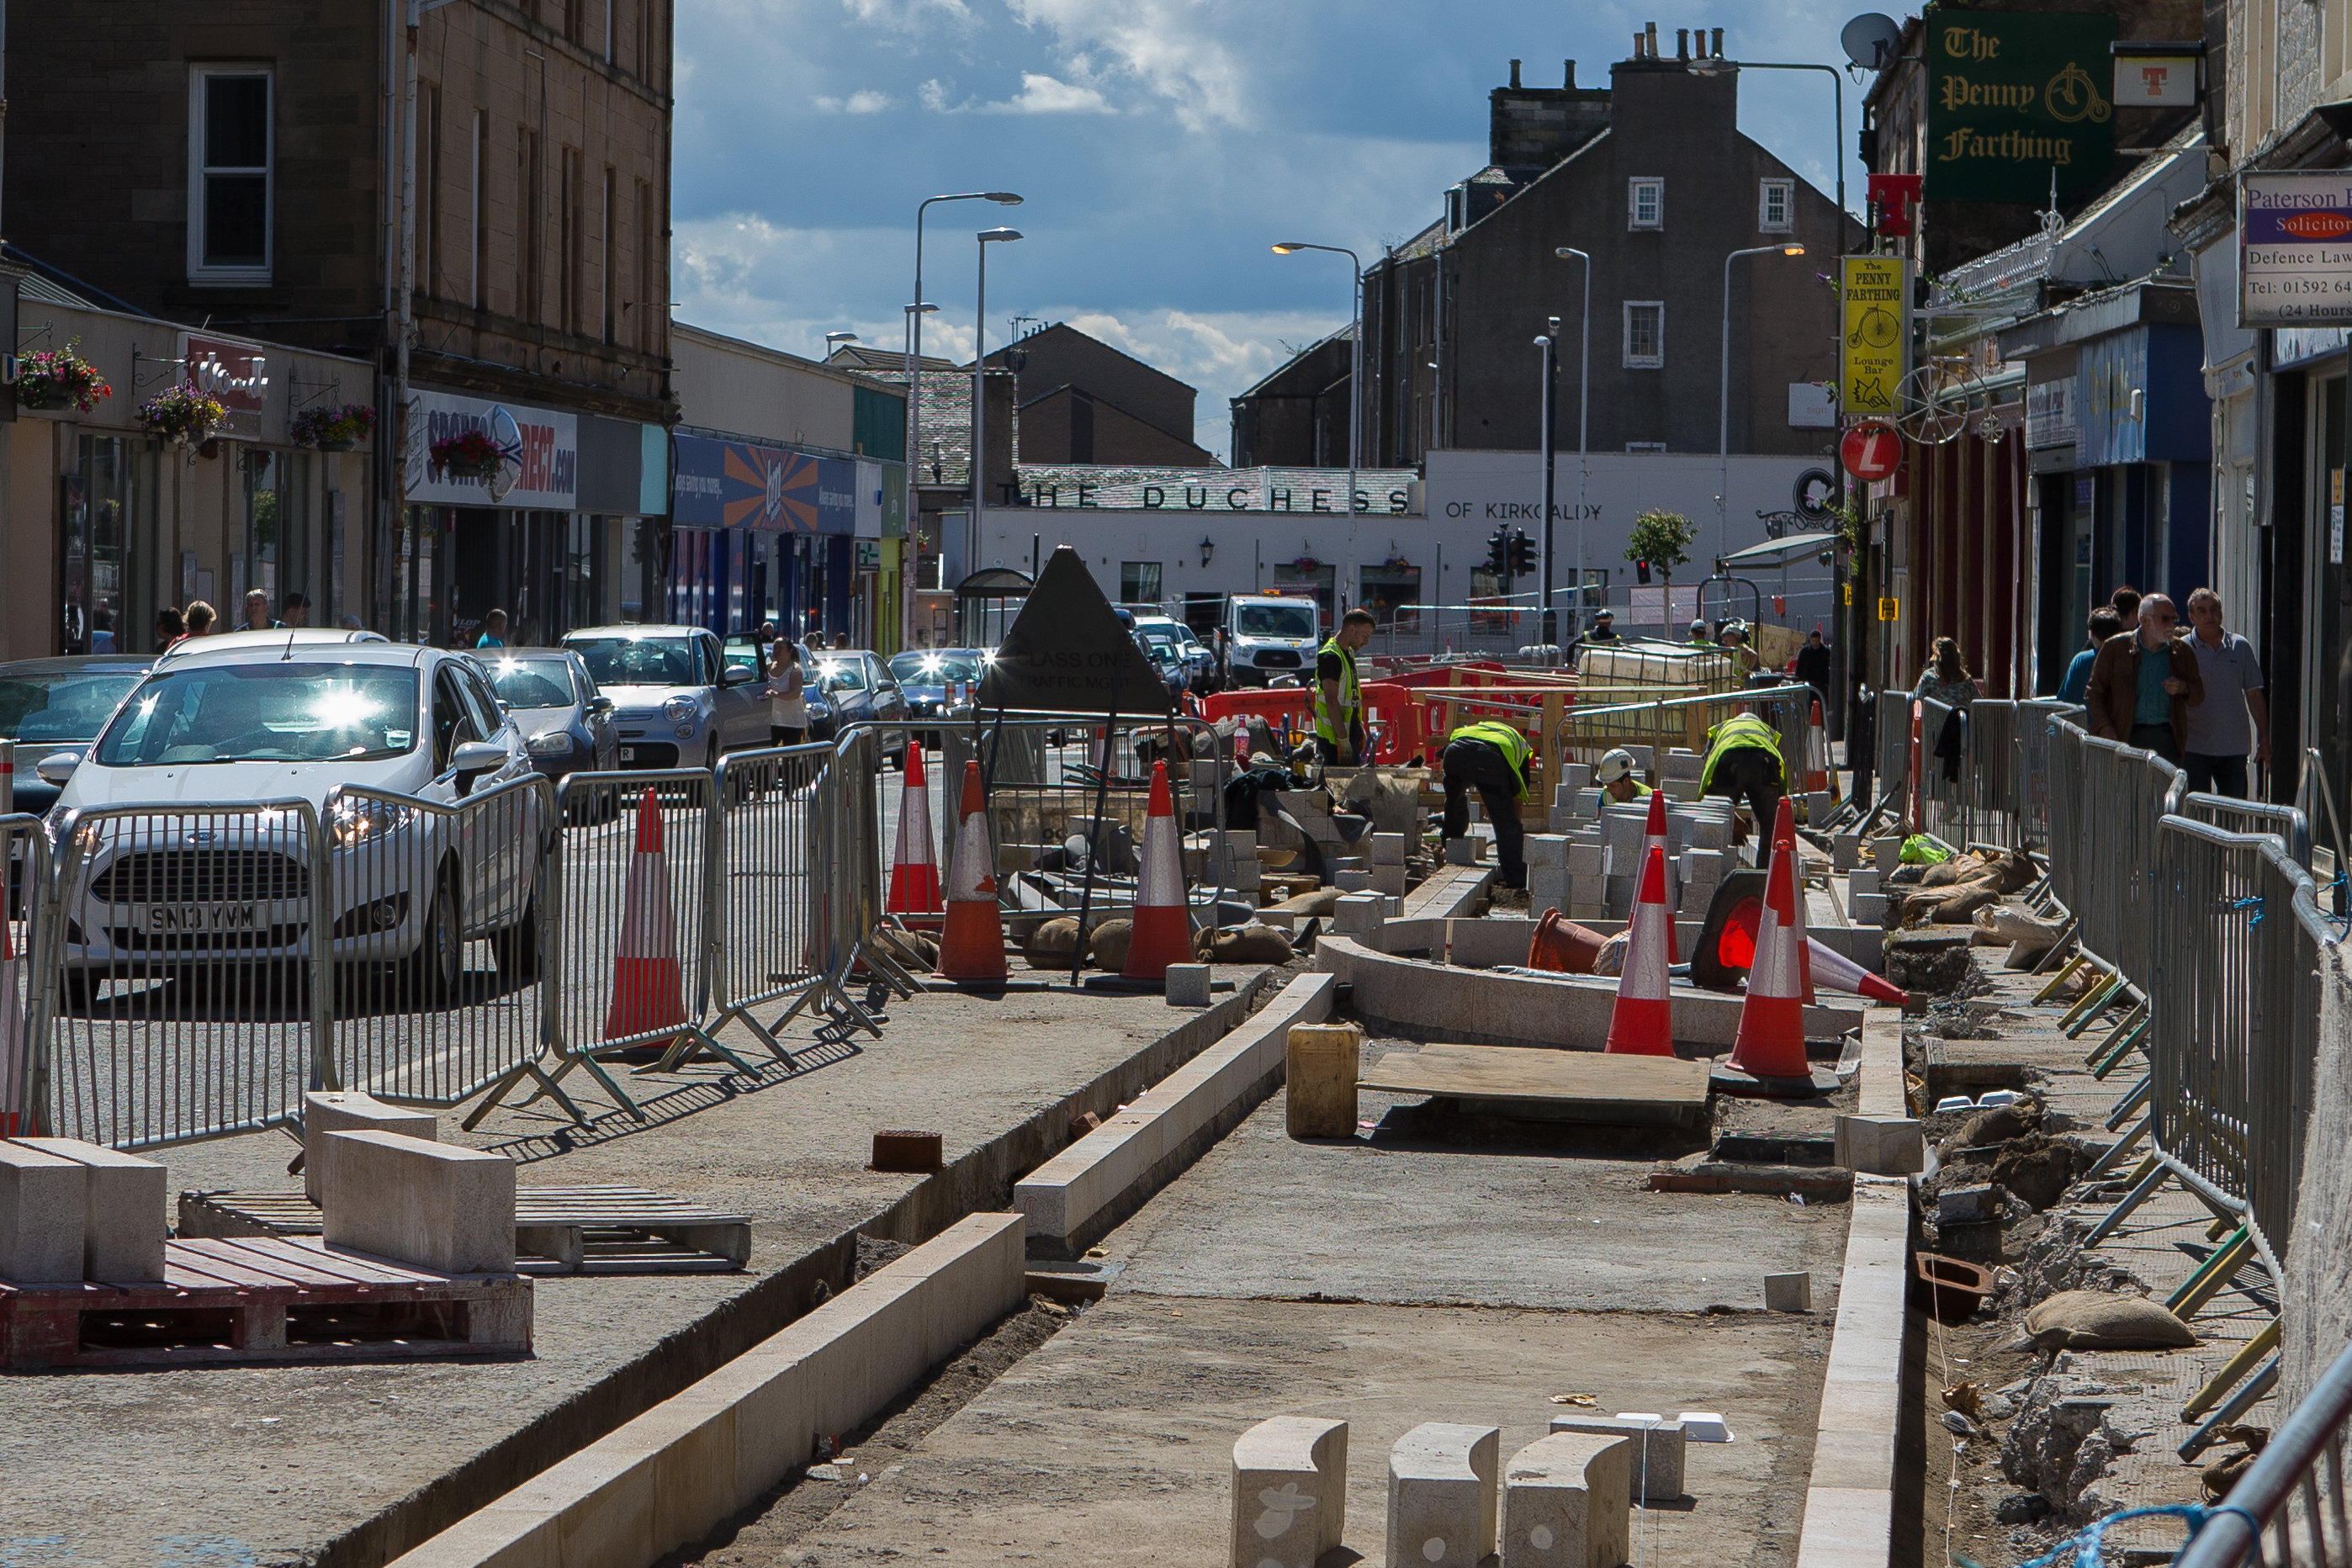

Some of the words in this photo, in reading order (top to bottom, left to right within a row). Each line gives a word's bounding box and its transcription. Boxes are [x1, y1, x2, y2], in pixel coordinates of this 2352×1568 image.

[1943, 26, 2000, 62] The
[1940, 75, 2036, 113] Penny
[1937, 127, 2072, 165] Farthing
[2248, 189, 2337, 209] Paterson
[2249, 251, 2314, 265] Defence
[1864, 262, 1882, 271] The
[1855, 273, 1892, 285] PENNY
[1846, 288, 1900, 301] FARTHING
[2249, 281, 2277, 294] Tel:
[2282, 280, 2328, 294] 01592
[2278, 304, 2302, 319] (24
[1853, 357, 1894, 367] Lounge
[1864, 366, 1884, 375] Bar
[515, 423, 575, 494] RECT.COM
[997, 483, 1099, 508] THE
[1142, 486, 1409, 513] DUCHESS
[1446, 502, 1473, 518] OF
[1015, 651, 1083, 668] CLASS
[1088, 652, 1133, 669] ONE
